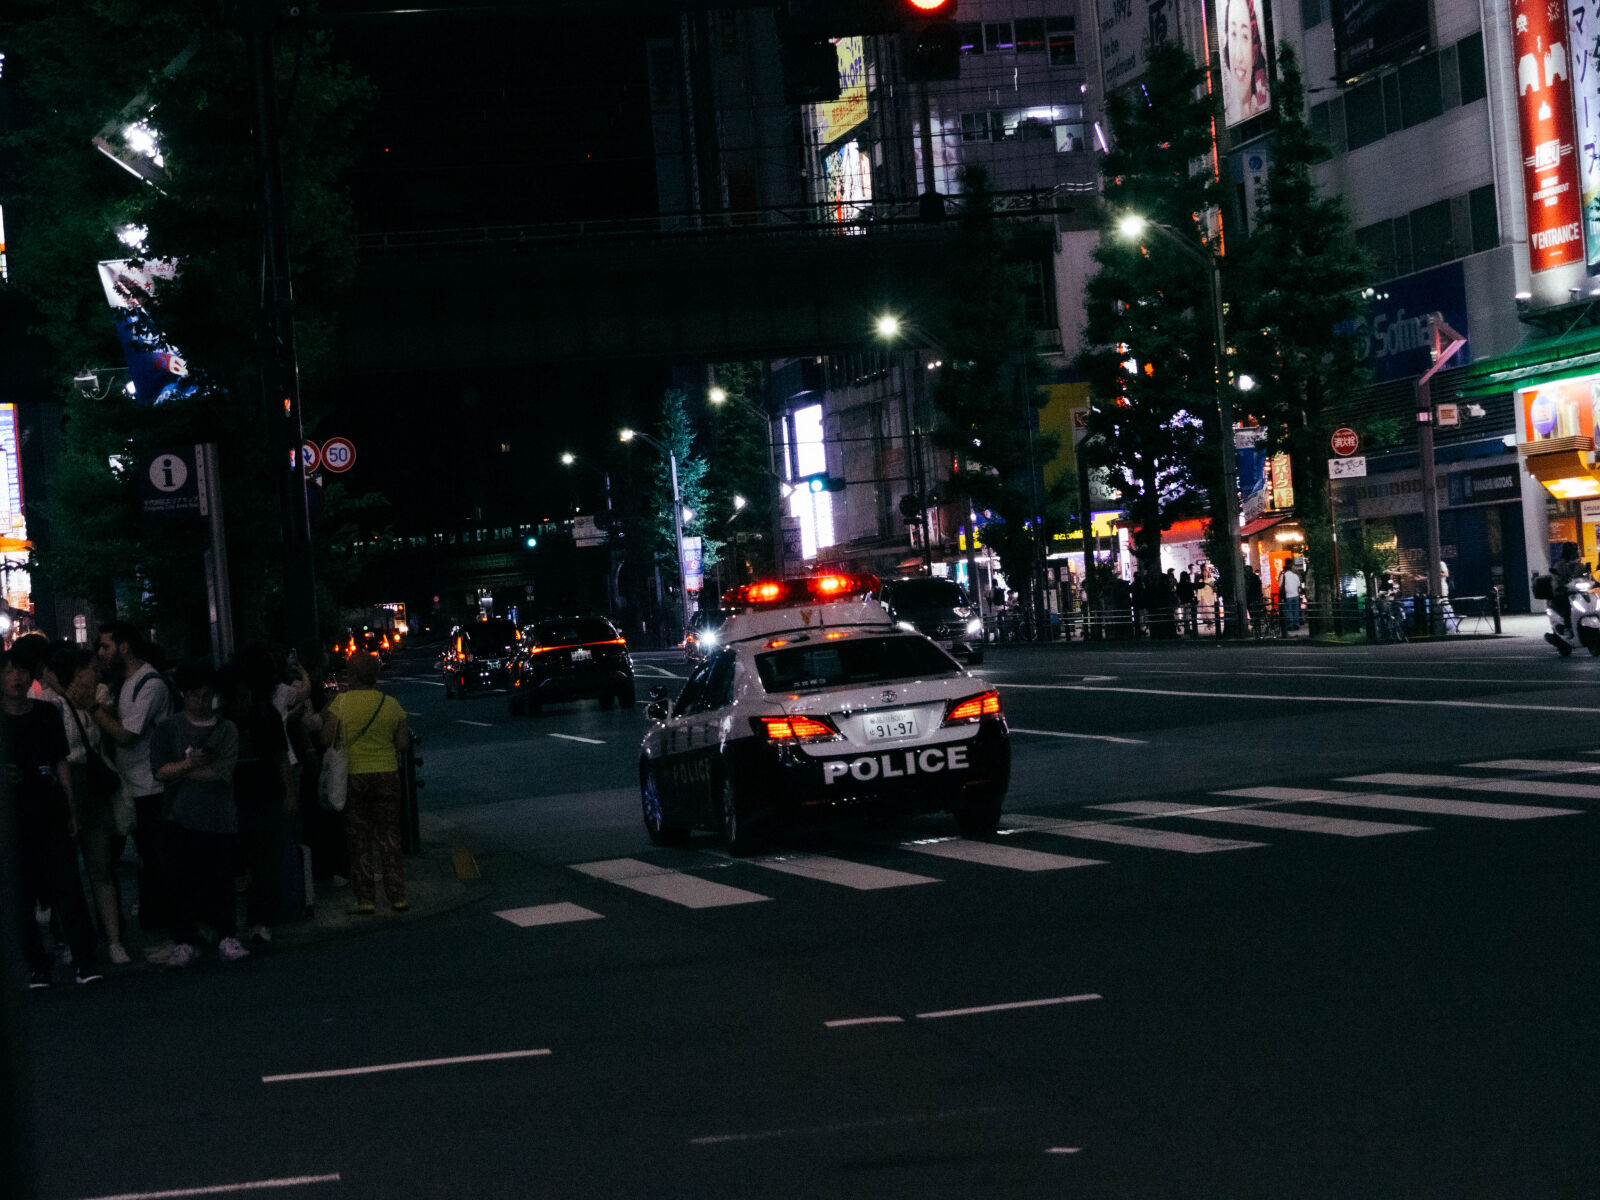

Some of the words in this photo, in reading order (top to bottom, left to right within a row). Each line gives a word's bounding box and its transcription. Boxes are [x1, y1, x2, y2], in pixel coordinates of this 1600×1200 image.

[1538, 222, 1580, 250] ENTRANCE
[329, 447, 348, 462] 50
[876, 721, 913, 738] 91-97
[822, 745, 970, 786] POLICE
